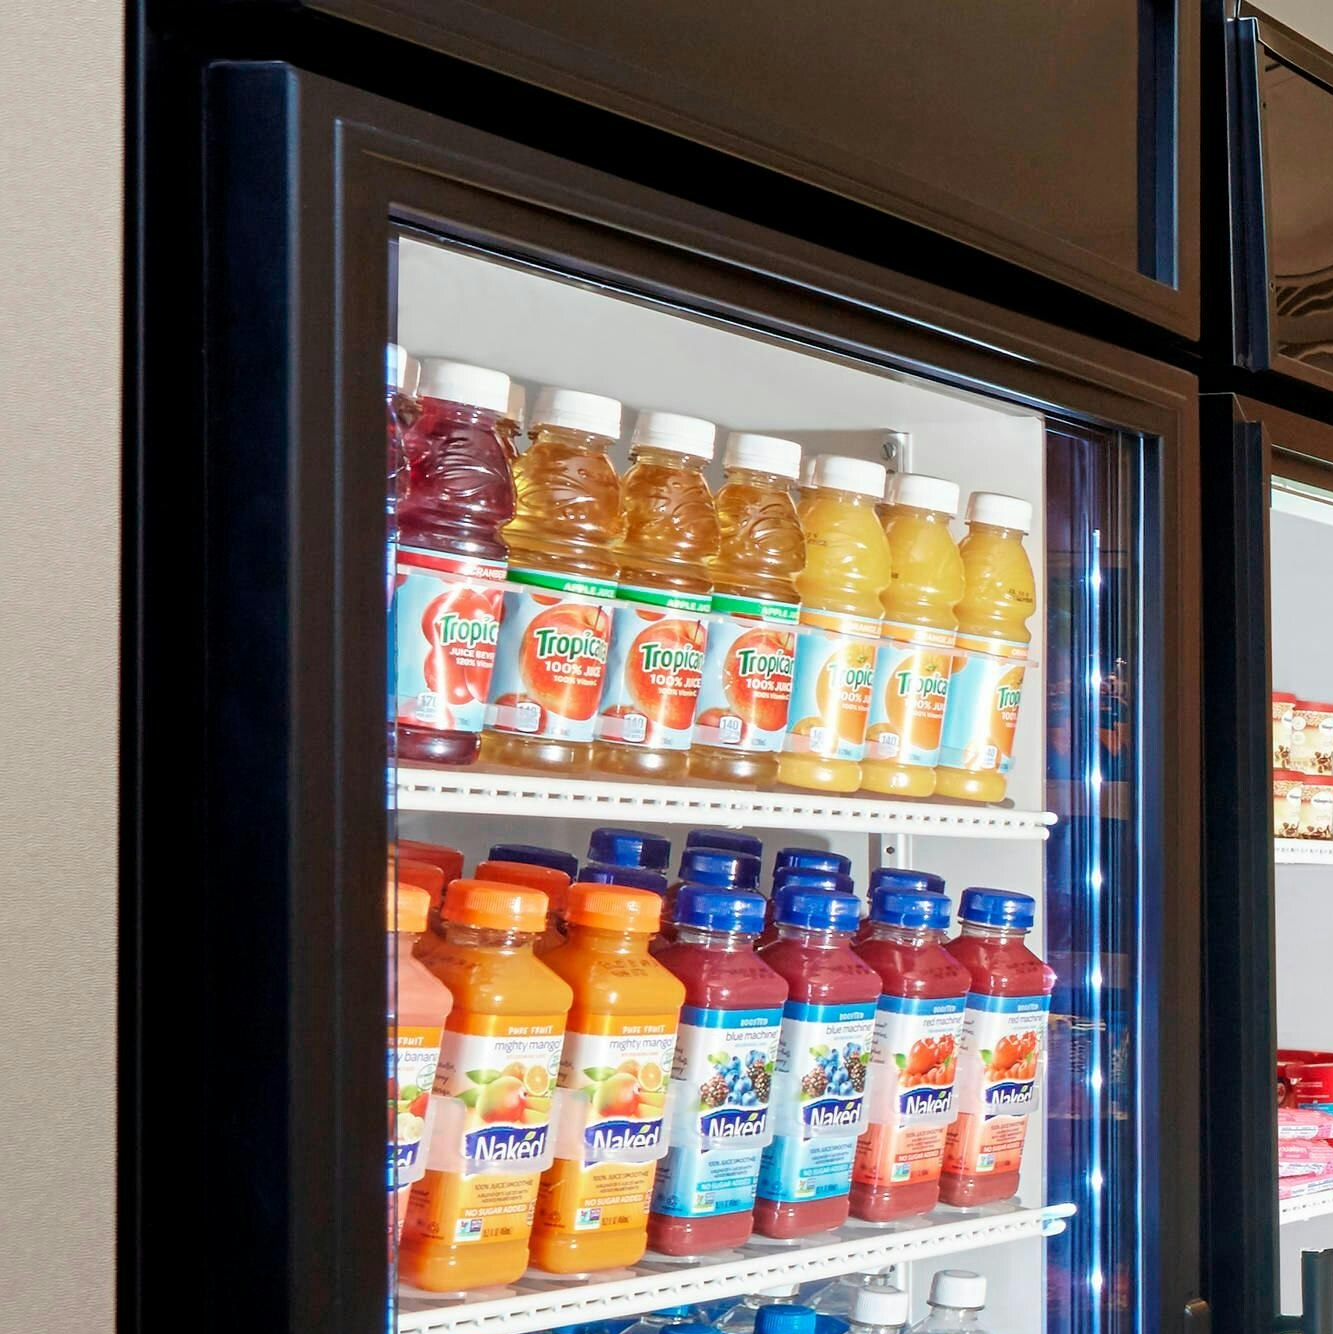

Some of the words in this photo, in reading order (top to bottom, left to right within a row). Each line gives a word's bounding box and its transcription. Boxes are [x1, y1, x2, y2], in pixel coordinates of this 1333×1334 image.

[725, 1031, 745, 1042] blue
[745, 1031, 777, 1042] machine
[825, 1025, 842, 1035] blue
[842, 1024, 872, 1034] machine
[494, 1040, 528, 1053] mighty
[609, 1038, 643, 1051] mighty
[905, 1092, 952, 1116] Naked
[991, 1086, 1033, 1105] Naked
[709, 1113, 766, 1138] Naked
[810, 1105, 861, 1126] Naked
[474, 1130, 545, 1161] Naked
[592, 1126, 661, 1158] Naked
